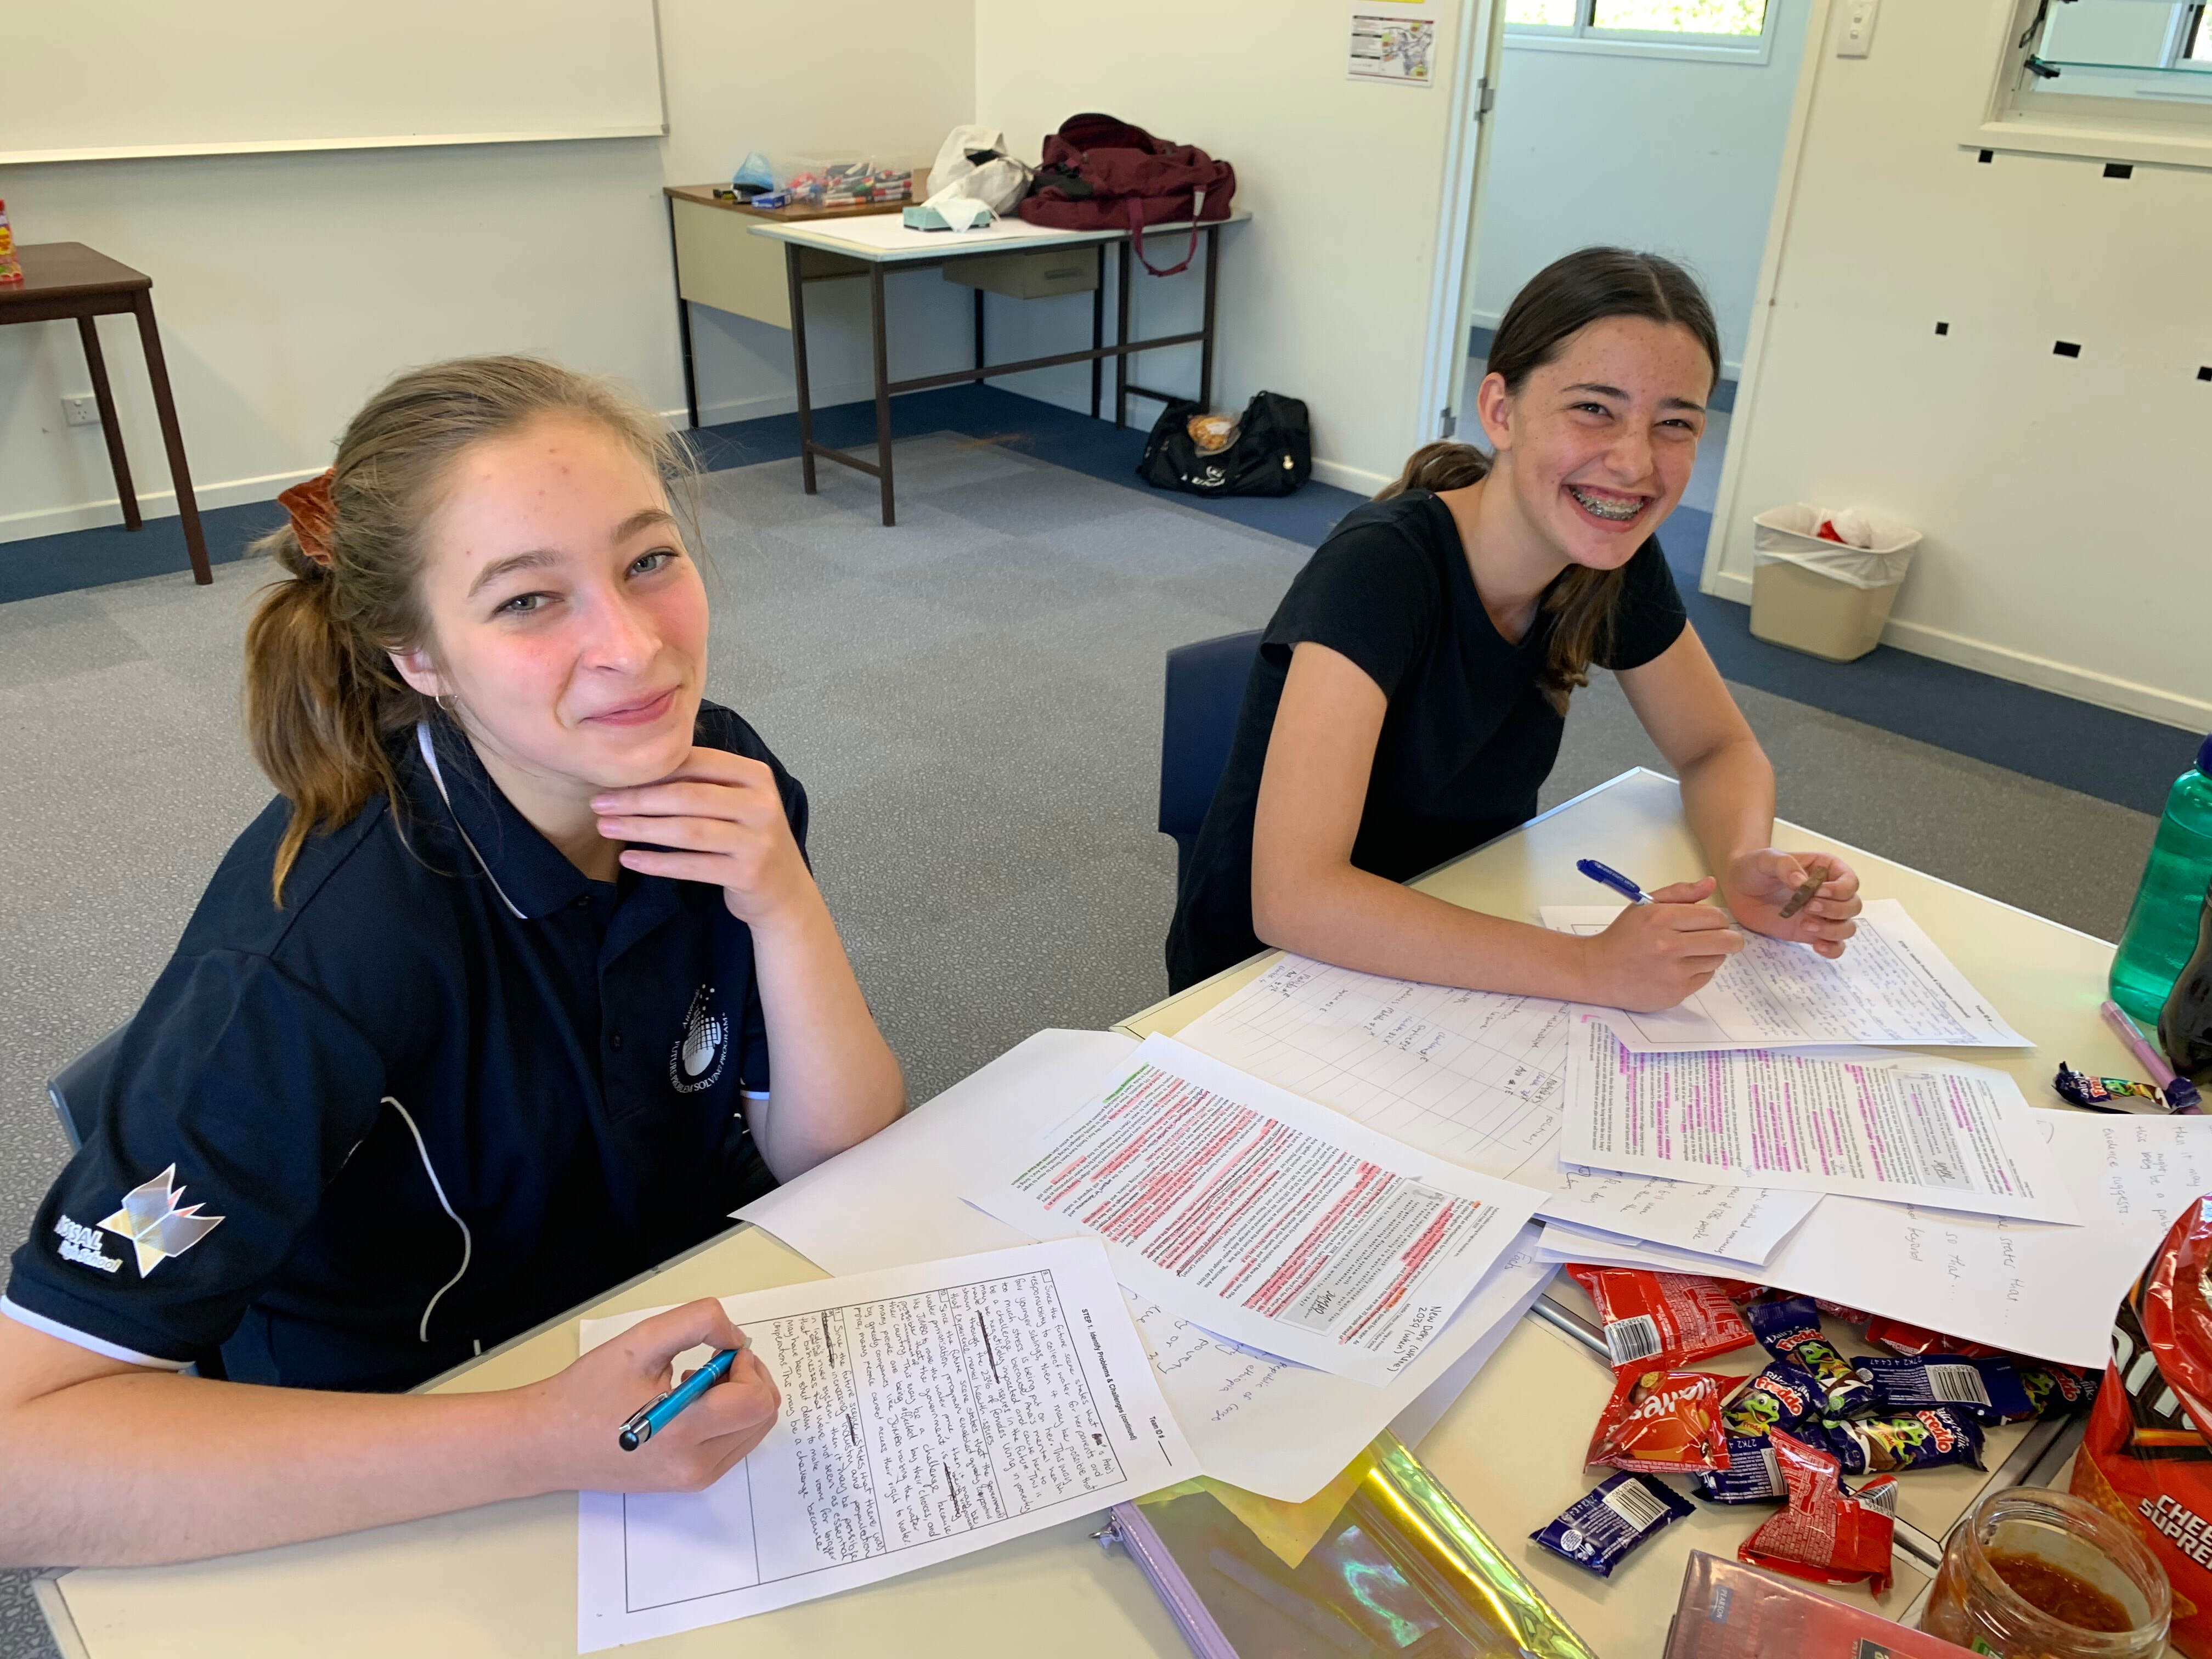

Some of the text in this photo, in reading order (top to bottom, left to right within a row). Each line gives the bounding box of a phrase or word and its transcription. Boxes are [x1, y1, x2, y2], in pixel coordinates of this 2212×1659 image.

[1409, 1307, 1427, 1328] 2039
[1426, 1306, 1441, 1322] New
[1415, 1325, 1433, 1341] Delhi
[1776, 1328, 1826, 1351] Freddo
[1372, 1340, 1384, 1352] Poverty
[1081, 1308, 1092, 1323] STEP
[1089, 1331, 1101, 1351] Identify
[1097, 1351, 1110, 1378] Problems
[1108, 1383, 1124, 1413] Challenges
[1119, 1413, 1137, 1441] (continued)
[1755, 1376, 1803, 1415] Freddo
[1149, 1415, 1159, 1429] Team
[1916, 1410, 1954, 1453] Freddo
[1714, 1588, 1728, 1620] PEARSON
